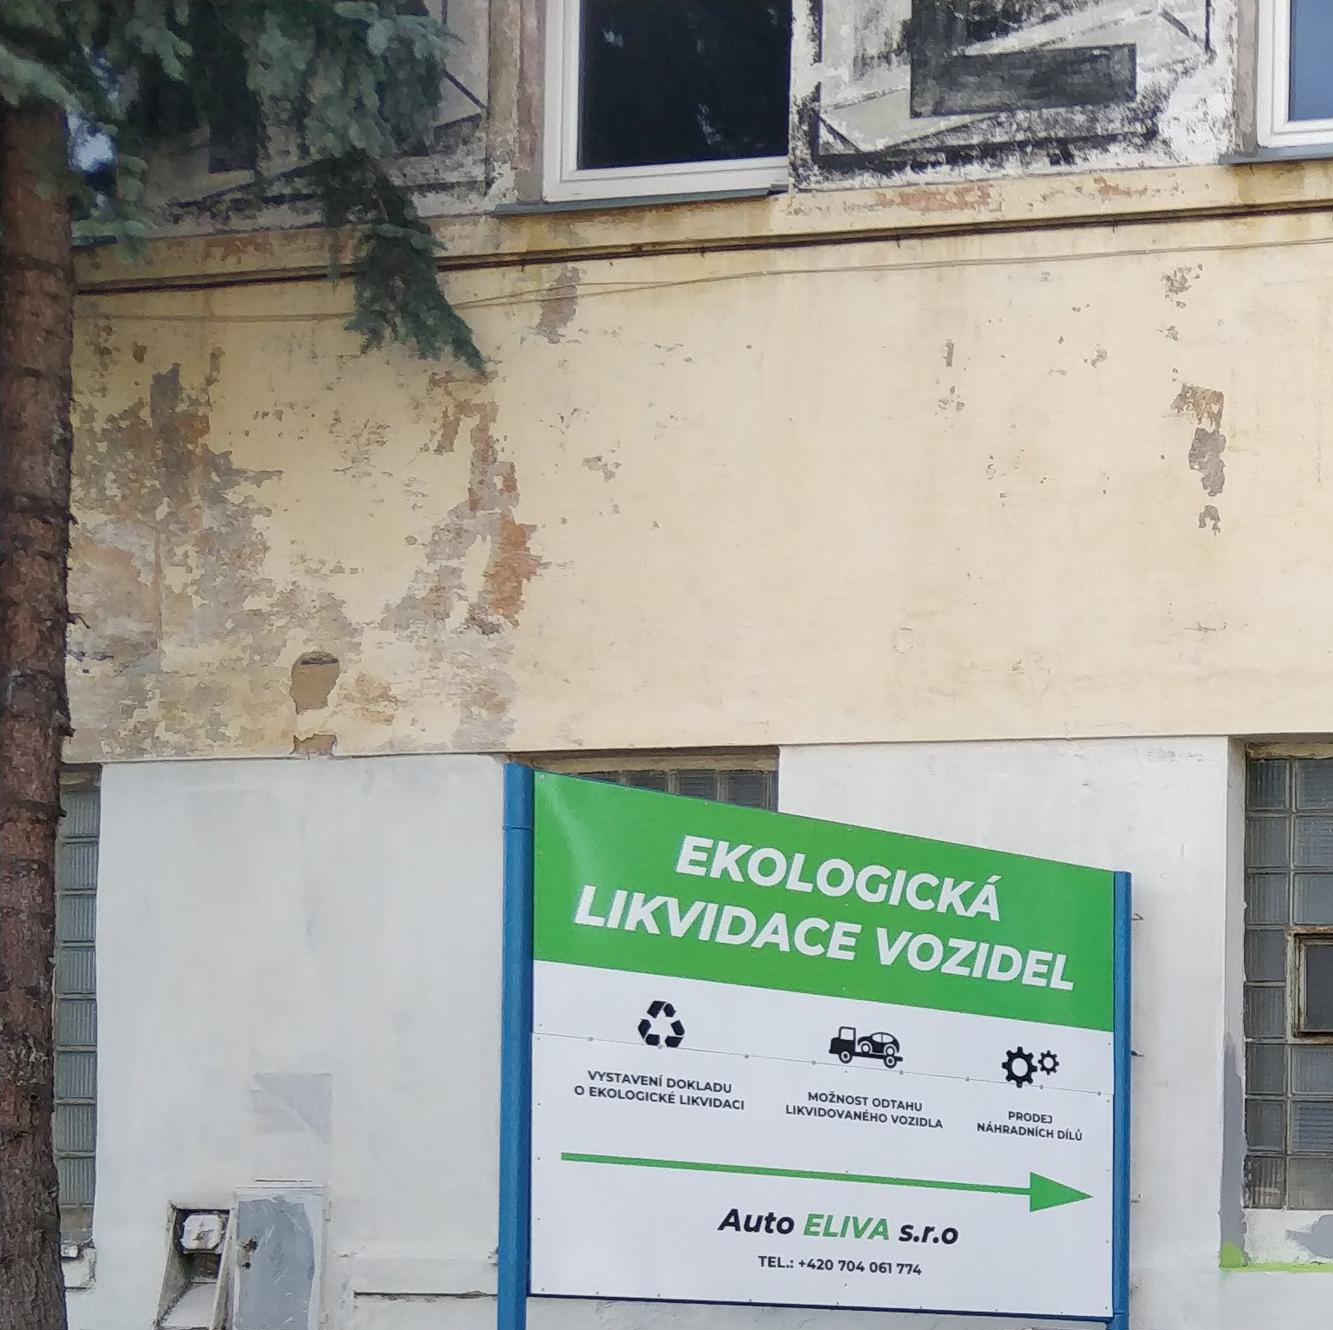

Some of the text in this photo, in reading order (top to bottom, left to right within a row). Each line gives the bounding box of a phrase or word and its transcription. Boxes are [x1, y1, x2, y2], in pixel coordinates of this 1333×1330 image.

[675, 835, 1002, 921] EKOLOGICKÁ
[574, 885, 1074, 991] LIKVIDACE VOZIDEL
[588, 1070, 732, 1093] VYSTAVENÍ DOKLADU
[574, 1085, 745, 1110] O EKOLOGICKÉ LIKVIDACI
[808, 1091, 923, 1112] MOŽNOST ODTAHU
[786, 1105, 943, 1129] LIKVIDOVANÉHO VOZIDLA
[1008, 1111, 1053, 1124] PRODEJ
[977, 1121, 1083, 1141] NÁHRADNÍCH DÍLŮ
[717, 1208, 959, 1245] Auto ELIVA s.r.o
[758, 1255, 922, 1276] TEL.: +420 704 061 774
